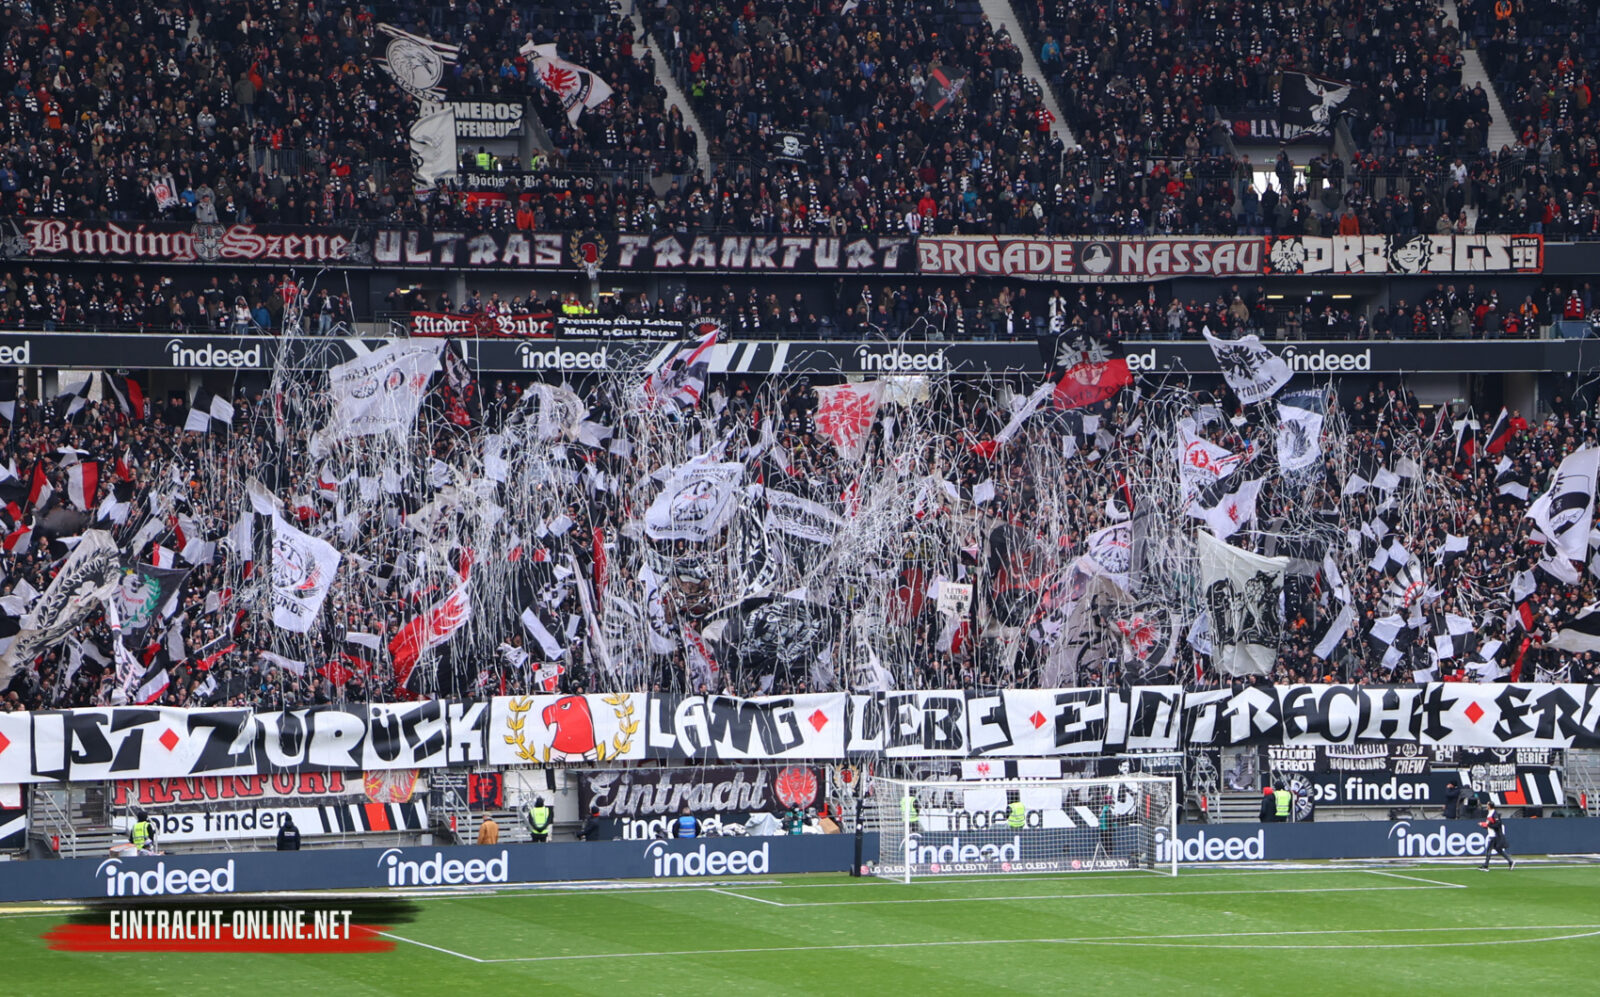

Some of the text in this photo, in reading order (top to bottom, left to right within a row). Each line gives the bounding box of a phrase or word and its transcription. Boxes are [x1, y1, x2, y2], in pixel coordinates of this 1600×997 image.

[25, 219, 348, 261] Binding Szene
[374, 230, 909, 268] ULTRAS FRANKFURT
[918, 241, 1260, 277] BRIGADE NASSAU
[1512, 247, 1537, 269] 99
[413, 315, 471, 334] Nieder
[557, 317, 683, 327] Freunde fürs Leben
[171, 343, 261, 368] indeed
[521, 345, 607, 370] indeed
[859, 347, 944, 371] indeed
[1286, 348, 1371, 371] indeed
[187, 699, 488, 776] ZURÜCK
[848, 691, 1012, 754] LEBE
[1268, 760, 1317, 771] VERBOT
[1329, 758, 1387, 770] HOOLIGANS
[1395, 759, 1426, 774] CREW
[1489, 763, 1516, 776] REGION
[1516, 751, 1550, 764] GEBIET
[588, 769, 768, 816] Eintracht
[1345, 777, 1429, 801] finden
[203, 807, 288, 832] finden
[909, 836, 1021, 865] indeed
[1155, 829, 1265, 862] indeed
[387, 848, 509, 886] indeed
[653, 842, 770, 877] indeed
[941, 863, 989, 872] LG OLED TV
[1012, 861, 1059, 871] LG OLED TV
[1117, 859, 1130, 867] TV
[105, 859, 235, 897] indeed
